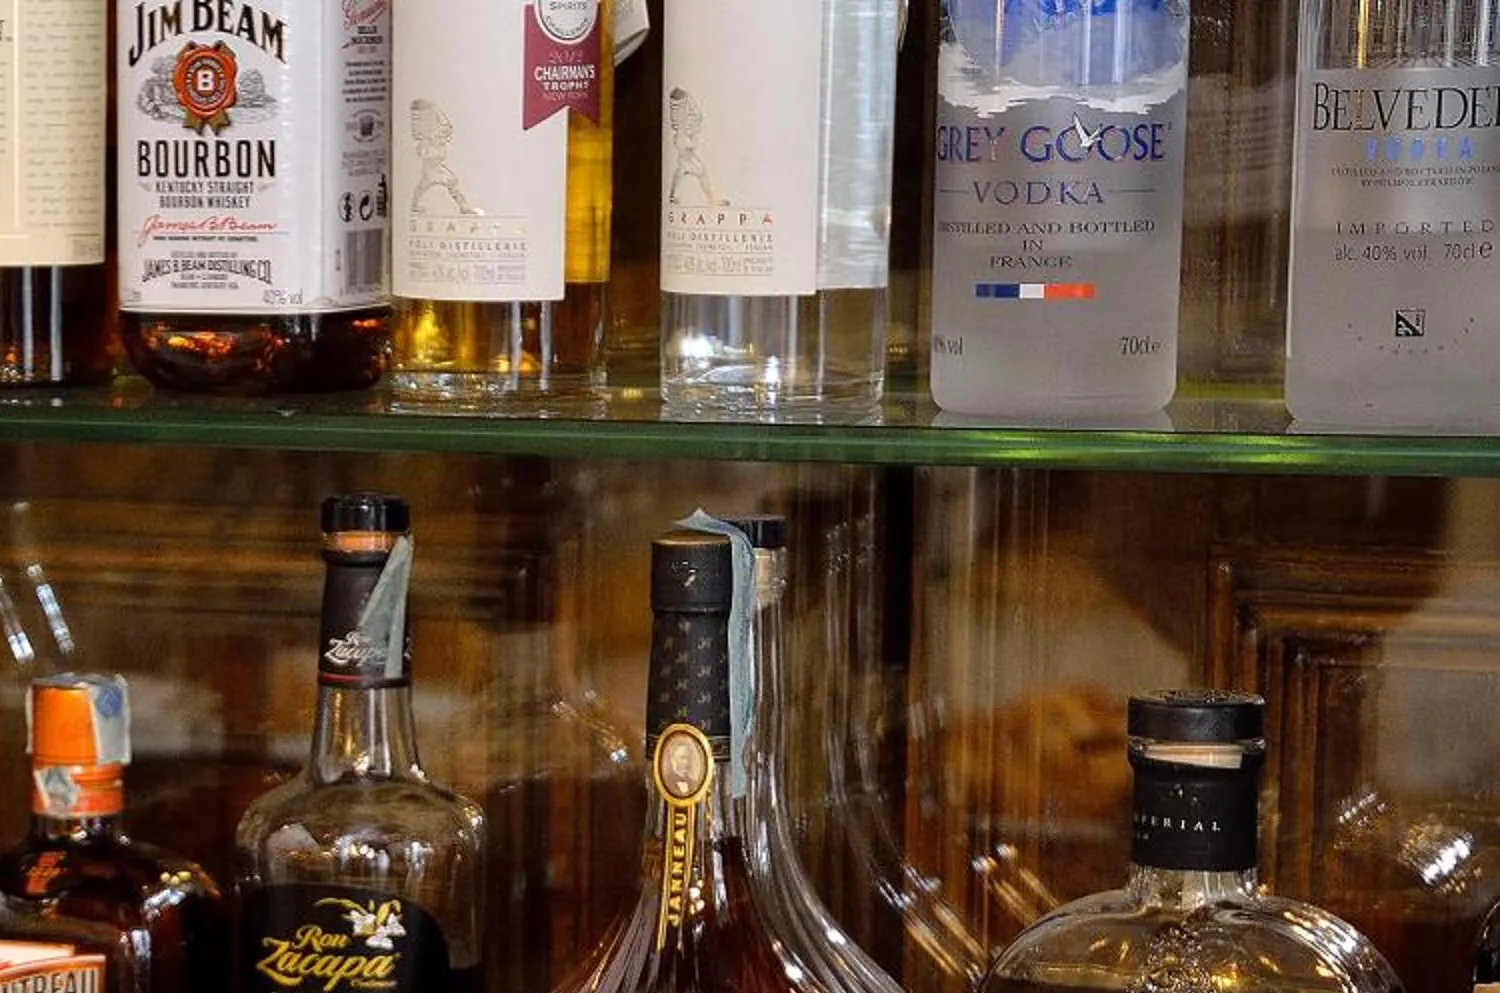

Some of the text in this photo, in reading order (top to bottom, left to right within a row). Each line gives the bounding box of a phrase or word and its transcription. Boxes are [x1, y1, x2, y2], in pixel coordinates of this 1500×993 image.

[129, 0, 184, 67] JIM
[191, 0, 288, 64] BEAM
[197, 69, 214, 91] B
[1313, 82, 1500, 131] BELVEDE
[938, 125, 1164, 162] GREY GOOSE
[137, 140, 276, 177] BOURBON
[207, 196, 251, 208] WHISKEY
[973, 180, 1105, 205] VODKA
[1015, 222, 1062, 235] AND
[1069, 220, 1156, 234] BOTTLED
[1336, 219, 1496, 235] IMPORTED
[1022, 240, 1043, 250] IN
[1362, 246, 1397, 261] 40%
[990, 255, 1073, 269] FRANCE
[1134, 814, 1221, 833] PERIAL
[668, 812, 687, 927] JANNEAU
[292, 925, 351, 953] Ron
[256, 937, 397, 992] Zacapa
